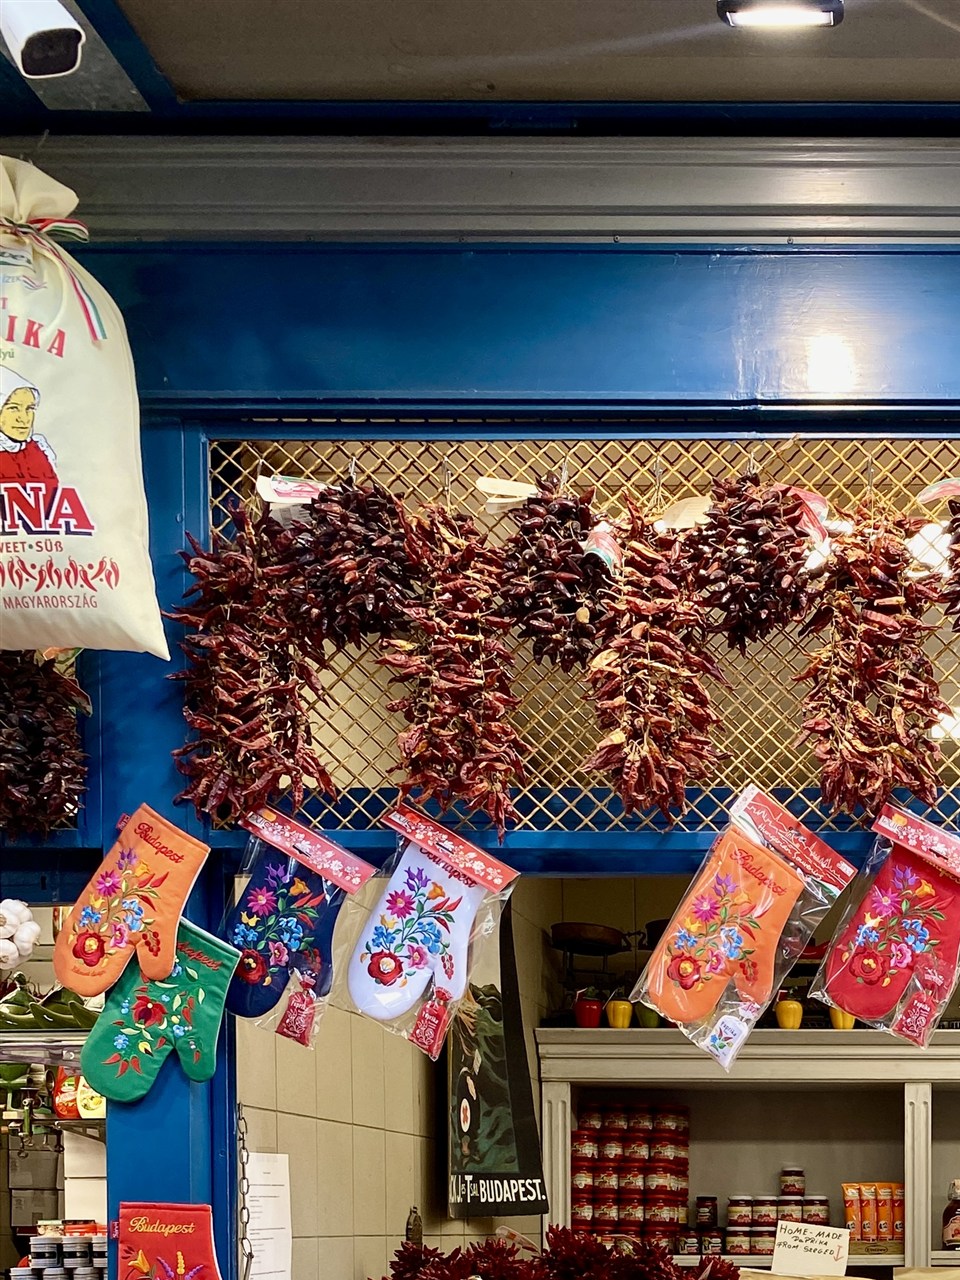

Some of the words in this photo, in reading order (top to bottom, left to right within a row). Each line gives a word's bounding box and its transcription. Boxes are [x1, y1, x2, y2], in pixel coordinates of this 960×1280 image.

[2, 593, 98, 610] MAGYARORSZÁG
[134, 821, 185, 864] Budapest
[729, 847, 787, 897] Budapest
[128, 1216, 196, 1237] Budapest
[776, 1241, 799, 1250] FROM
